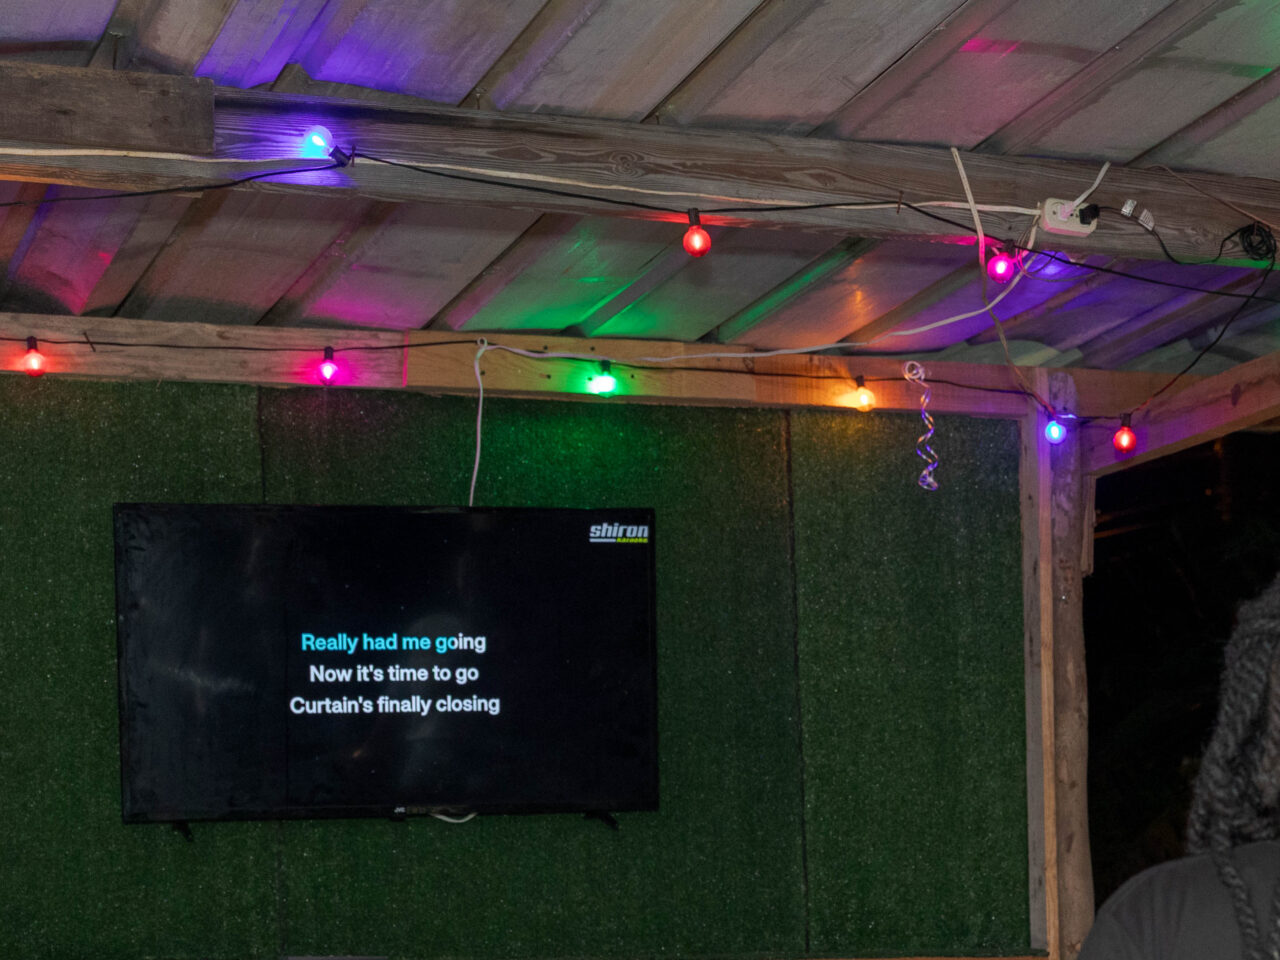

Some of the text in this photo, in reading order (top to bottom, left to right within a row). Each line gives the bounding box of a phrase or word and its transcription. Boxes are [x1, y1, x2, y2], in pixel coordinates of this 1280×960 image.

[589, 522, 649, 537] shiron
[301, 632, 487, 655] Really had me going
[309, 664, 479, 685] Now it's time to go
[289, 694, 500, 716] Curtain's finally closing
